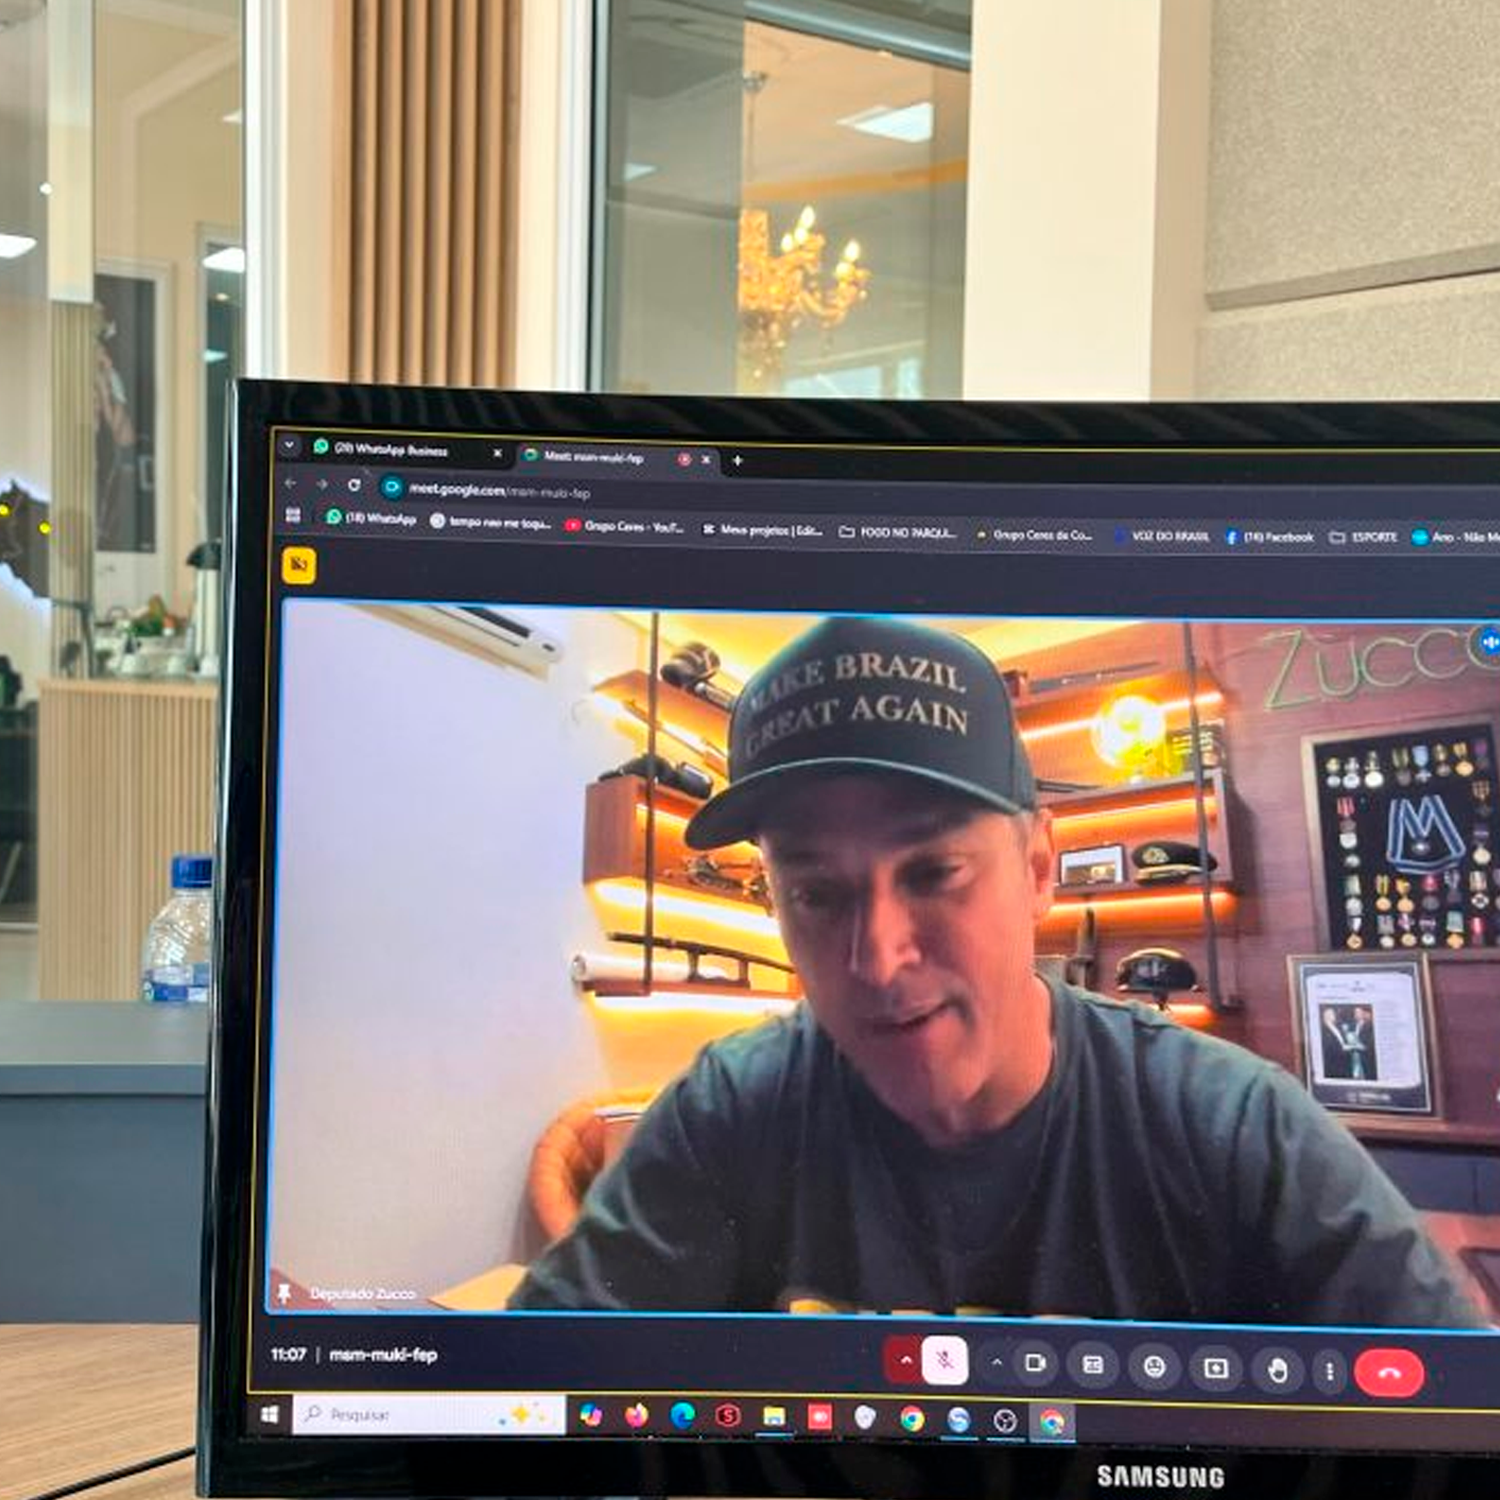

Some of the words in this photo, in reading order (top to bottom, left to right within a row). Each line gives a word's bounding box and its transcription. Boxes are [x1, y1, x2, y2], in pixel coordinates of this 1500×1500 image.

[356, 442, 405, 456] WhatsApp
[407, 444, 447, 457] Business
[367, 513, 417, 527] WhatsApp
[449, 516, 482, 529] tempo
[584, 520, 615, 534] Grupo
[892, 526, 909, 538] NO
[994, 529, 1025, 543] Grupo
[1026, 530, 1055, 541] Ceres
[1133, 531, 1154, 542] VOZ
[1156, 531, 1173, 542] DO
[1265, 531, 1315, 543] Facebook
[1353, 532, 1398, 543] ESPORTE
[750, 660, 825, 712] MAKE
[835, 651, 967, 693] BRAZIL
[744, 698, 841, 760] GREAT
[851, 694, 968, 736] AGAIN
[311, 1286, 374, 1301] Deputado
[376, 1287, 417, 1300] Zucco
[271, 1347, 307, 1362] 11:07
[331, 1408, 389, 1423] Pesquisar
[1097, 1464, 1225, 1489] SAMSUNG
